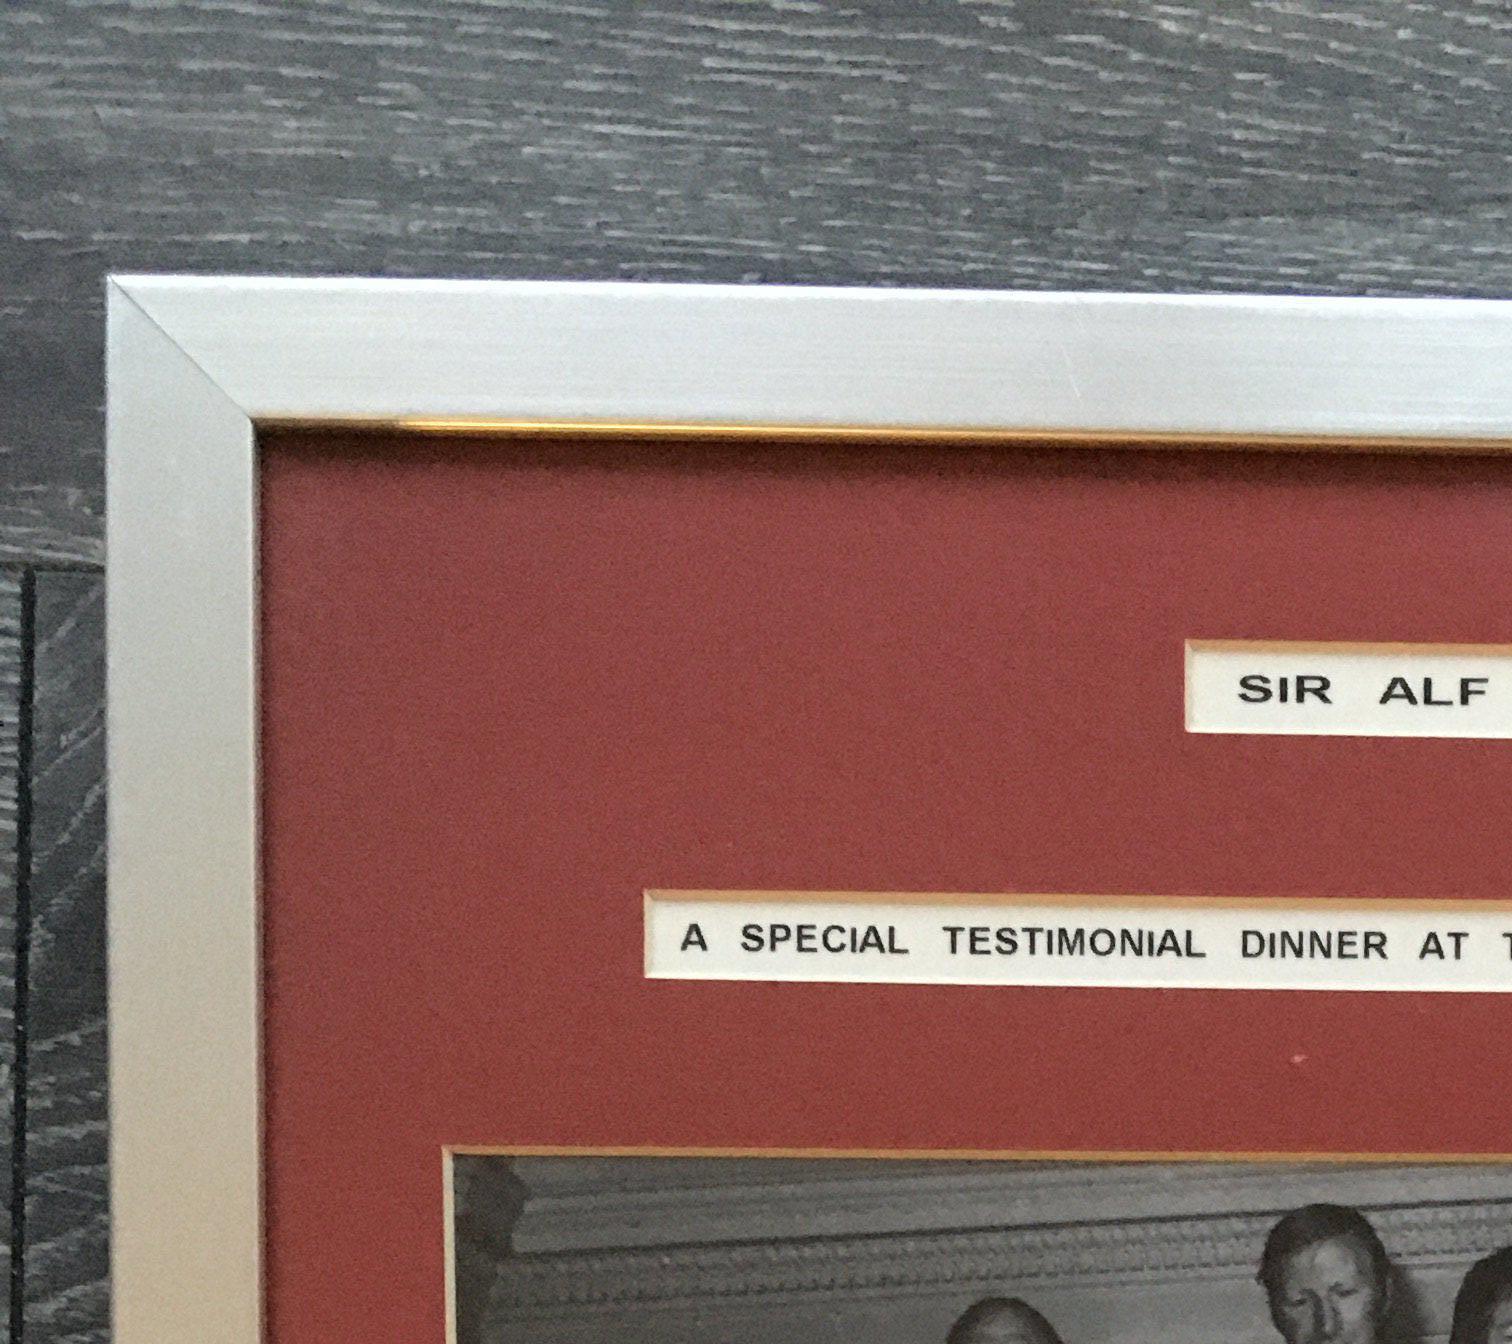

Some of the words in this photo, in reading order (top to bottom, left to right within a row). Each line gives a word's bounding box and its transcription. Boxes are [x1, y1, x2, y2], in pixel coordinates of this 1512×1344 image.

[1237, 674, 1333, 705] SIR
[1378, 676, 1490, 707] ALF
[679, 922, 709, 952] A
[740, 922, 910, 955] SPECIAL
[941, 925, 1207, 959] TESTIMONIAL
[1240, 929, 1388, 960] DINNER
[1418, 930, 1470, 961] AT
